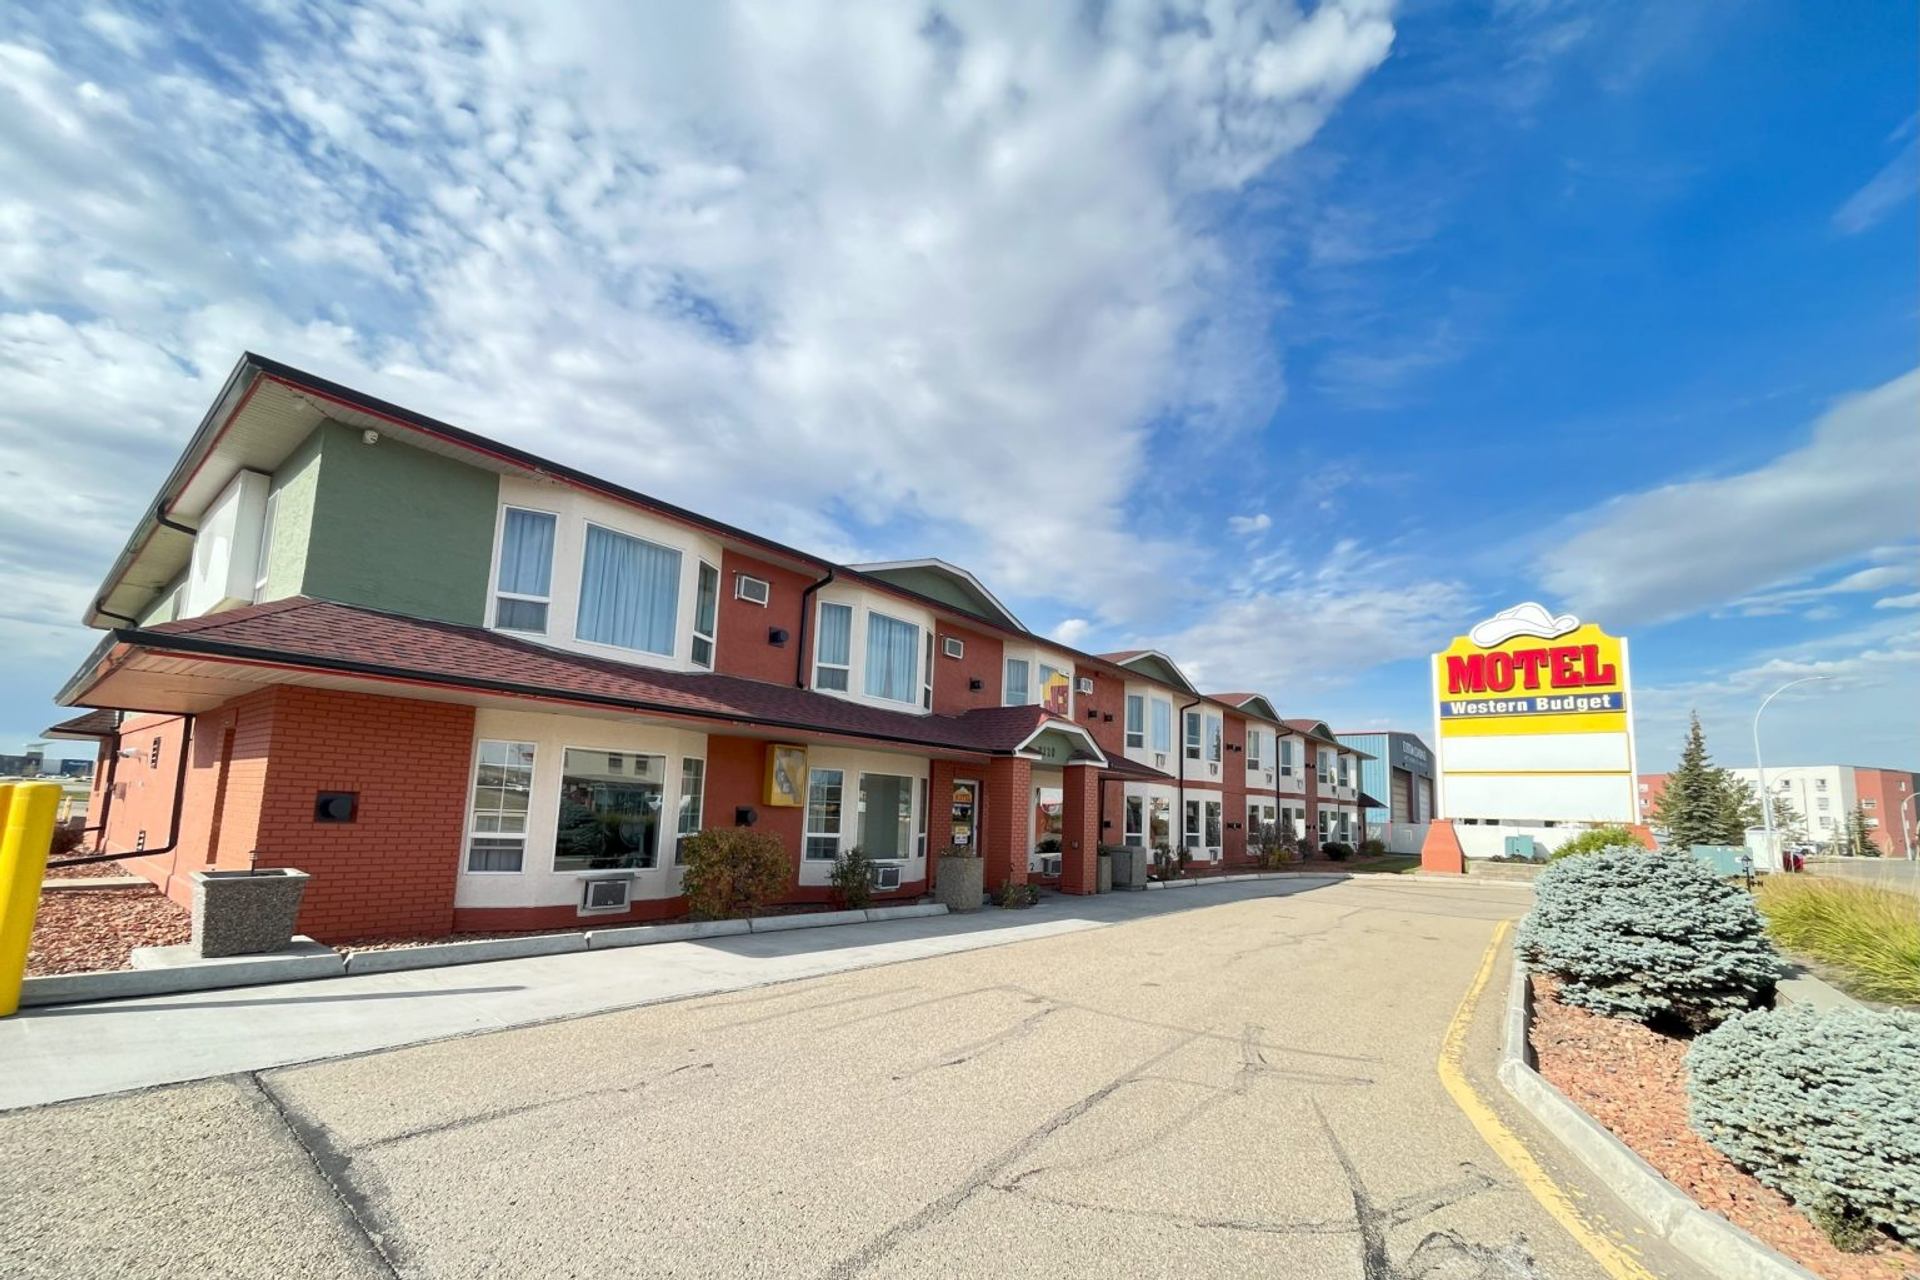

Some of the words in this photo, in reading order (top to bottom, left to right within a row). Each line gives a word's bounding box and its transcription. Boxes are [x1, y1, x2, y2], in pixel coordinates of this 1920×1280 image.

[1447, 644, 1616, 693] MOTEL
[1451, 701, 1528, 714] Western
[1536, 694, 1611, 712] Budget
